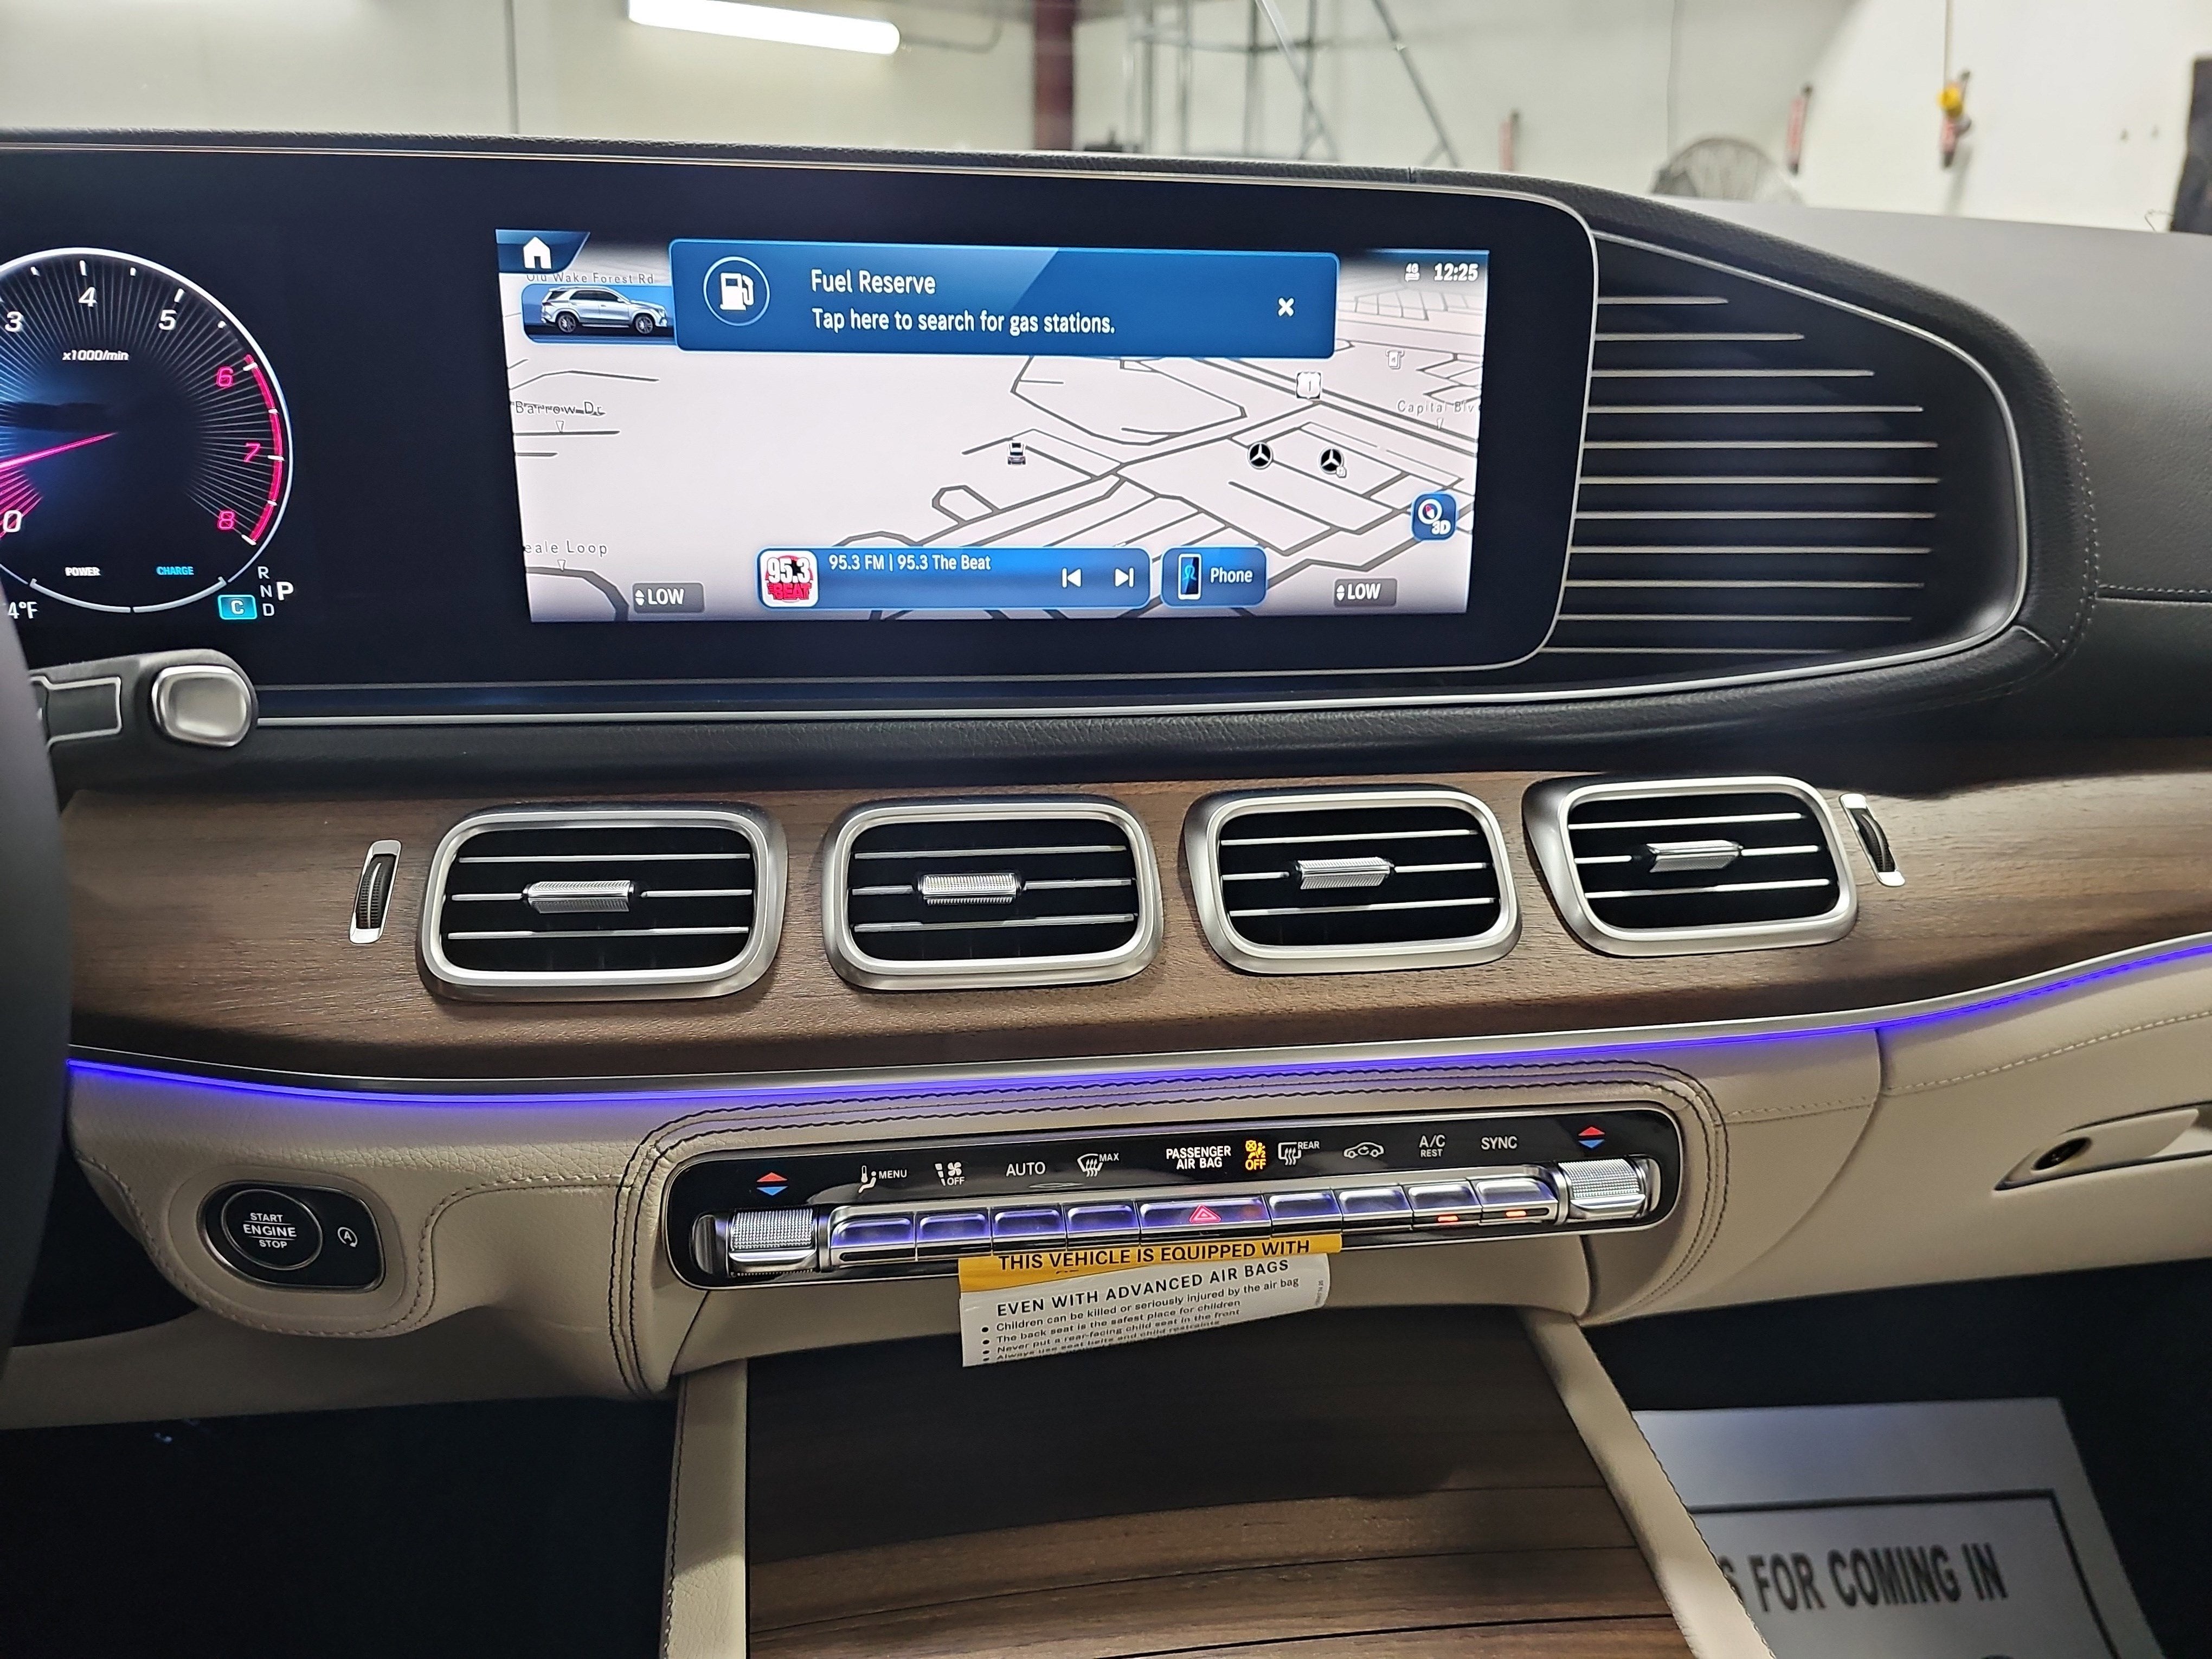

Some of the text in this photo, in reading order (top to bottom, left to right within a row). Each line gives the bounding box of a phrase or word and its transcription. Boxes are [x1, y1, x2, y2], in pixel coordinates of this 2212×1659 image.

[552, 273, 587, 282] Wake
[593, 273, 633, 284] Forest
[638, 274, 654, 284] Rd
[1434, 263, 1478, 281] 12:25
[811, 269, 936, 294] Fuel Reserve
[79, 287, 97, 307] 4
[6, 311, 23, 332] 3
[158, 309, 176, 331] 5
[812, 308, 1115, 336] Tap here to search for gas stations.
[62, 350, 129, 362] x1000/min
[217, 367, 233, 387] 6
[515, 401, 575, 414] Barrow
[1398, 400, 1446, 416] Capital
[244, 443, 260, 462] 7
[3, 511, 22, 532] 0
[218, 511, 235, 529] 8
[1431, 520, 1451, 535] 3D
[524, 541, 608, 557] eale Loop
[156, 566, 194, 575] CHARGE
[767, 557, 811, 583] 95.3
[828, 554, 860, 570] 95.3
[865, 554, 885, 570] FM
[897, 555, 928, 571] 95.3
[932, 555, 957, 571] The
[961, 555, 991, 571] Beat
[65, 567, 101, 576] POWER
[258, 567, 269, 579] R
[1210, 567, 1253, 584] Phone
[260, 586, 272, 597] N
[277, 582, 294, 600] P
[647, 588, 685, 605] LOW
[767, 583, 812, 600] BEAT
[1347, 583, 1381, 600] LOW
[231, 601, 244, 615] C
[263, 604, 275, 616] D
[1298, 1141, 1320, 1150] REAR
[1419, 1134, 1446, 1149] A/C
[1481, 1136, 1518, 1150] SYNC
[1098, 1153, 1120, 1162] MAX
[1166, 1145, 1231, 1159] PASSENGER
[1420, 1149, 1443, 1158] REST
[1006, 1161, 1046, 1177] AUTO
[1176, 1157, 1223, 1169] AIR BAG
[1245, 1159, 1266, 1171] OFF
[879, 1169, 908, 1180] MENU
[947, 1176, 965, 1186] OFF
[250, 1212, 283, 1223] START
[243, 1224, 297, 1237] ENGINE
[259, 1239, 287, 1249] STOP
[999, 1239, 1310, 1270] THIS VEHICLE IS EQUIPPED WITH
[997, 1259, 1289, 1317] EVEN WITH ADVANCED AIR BAGS
[996, 1276, 1299, 1332] Children can be killed or seriously injured by the air bag
[996, 1334, 1017, 1344] The
[1020, 1329, 1046, 1340] back
[1050, 1325, 1074, 1335] seat
[1090, 1320, 1107, 1328] the
[1111, 1314, 1143, 1325] safest
[1147, 1310, 1176, 1321] place
[1180, 1307, 1194, 1315] for
[1197, 1300, 1240, 1313] children
[997, 1343, 1029, 1354] Never
[1033, 1339, 1051, 1348] put
[1064, 1328, 1122, 1343] rear-facing
[1126, 1322, 1152, 1332] child
[1155, 1319, 1177, 1327] seat
[1214, 1309, 1240, 1319] front
[1747, 1552, 1826, 1612] FOR
[1827, 1544, 1963, 1607] COMING
[1961, 1542, 2009, 1601] IN
